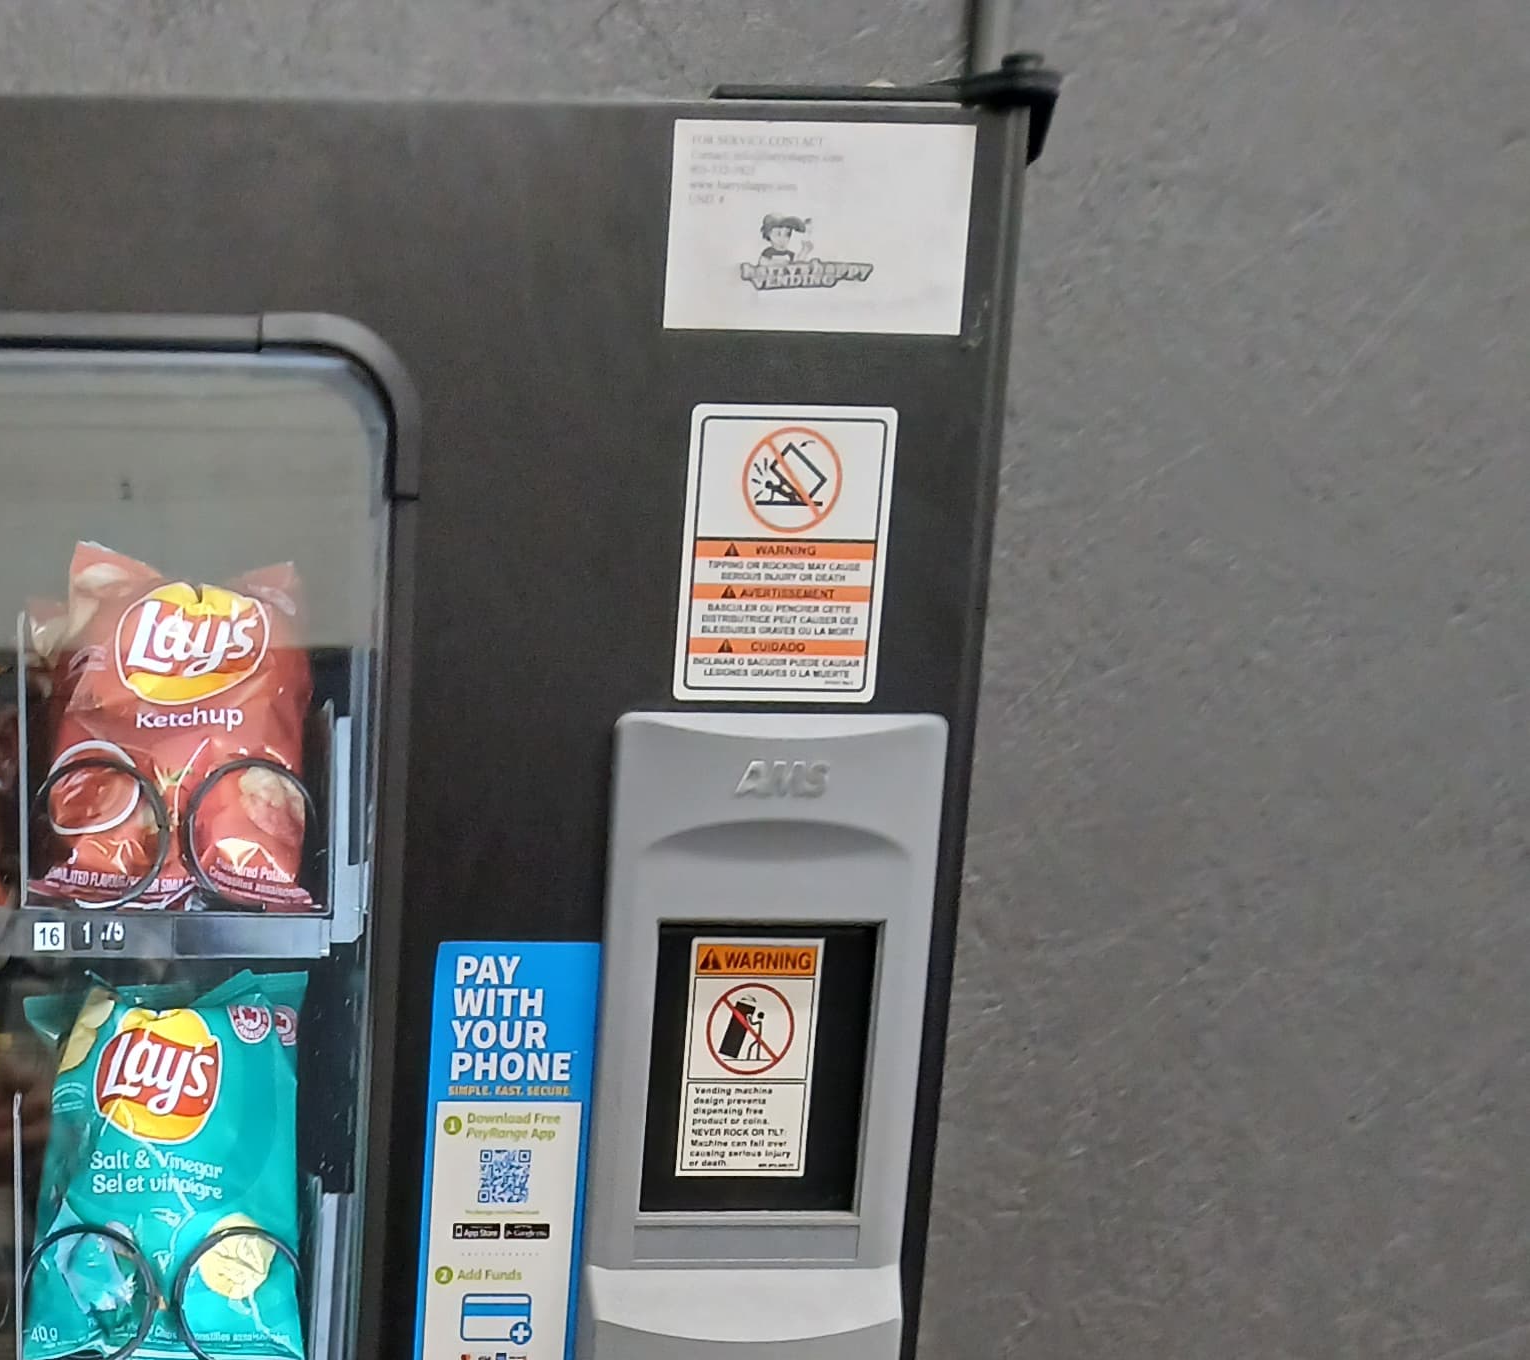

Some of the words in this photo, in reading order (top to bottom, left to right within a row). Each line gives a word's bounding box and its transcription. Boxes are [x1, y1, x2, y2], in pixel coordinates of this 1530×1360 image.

[755, 545, 817, 557] WARNING
[746, 560, 760, 570] OR
[807, 562, 827, 571] MAY
[828, 562, 861, 572] CAUSE
[739, 588, 836, 600] AVERTISSEMENT
[126, 599, 255, 677] Lay's
[750, 641, 807, 653] CUIDADO
[136, 705, 244, 732] Ketchup
[734, 760, 831, 798] AMS
[39, 926, 60, 946] 16
[724, 951, 812, 972] WARNING
[455, 955, 521, 985] PAY
[453, 987, 545, 1018] WITH
[450, 1020, 548, 1050] YOUR
[101, 1031, 215, 1115] Lay's
[449, 1052, 572, 1082] PHONE
[694, 1087, 732, 1097] Vending
[734, 1087, 773, 1095] machine
[693, 1097, 724, 1106] design
[727, 1097, 767, 1106] prevents
[467, 1111, 532, 1124] Download
[533, 1112, 561, 1124] Free
[693, 1107, 743, 1116] dispensing
[745, 1107, 764, 1115] free
[692, 1118, 728, 1127] product
[466, 1127, 528, 1141] PayRange
[530, 1127, 556, 1141] App
[691, 1128, 721, 1137] NEVER
[723, 1128, 749, 1137] ROCK
[751, 1128, 764, 1137] OR
[690, 1139, 728, 1148] Machine
[731, 1140, 748, 1148] can
[749, 1139, 765, 1148] fall
[767, 1140, 787, 1148] over
[689, 1150, 725, 1159] causing
[728, 1150, 762, 1158] serious
[764, 1150, 792, 1159] injury
[89, 1150, 131, 1171] Salt
[134, 1149, 151, 1170] &
[155, 1149, 223, 1180] Vinegar
[92, 1172, 123, 1194] Sel
[125, 1173, 145, 1194] et
[149, 1173, 223, 1201] vinaigre
[457, 1267, 480, 1281] Add
[483, 1267, 523, 1281] Funds
[30, 1324, 48, 1344] 40
